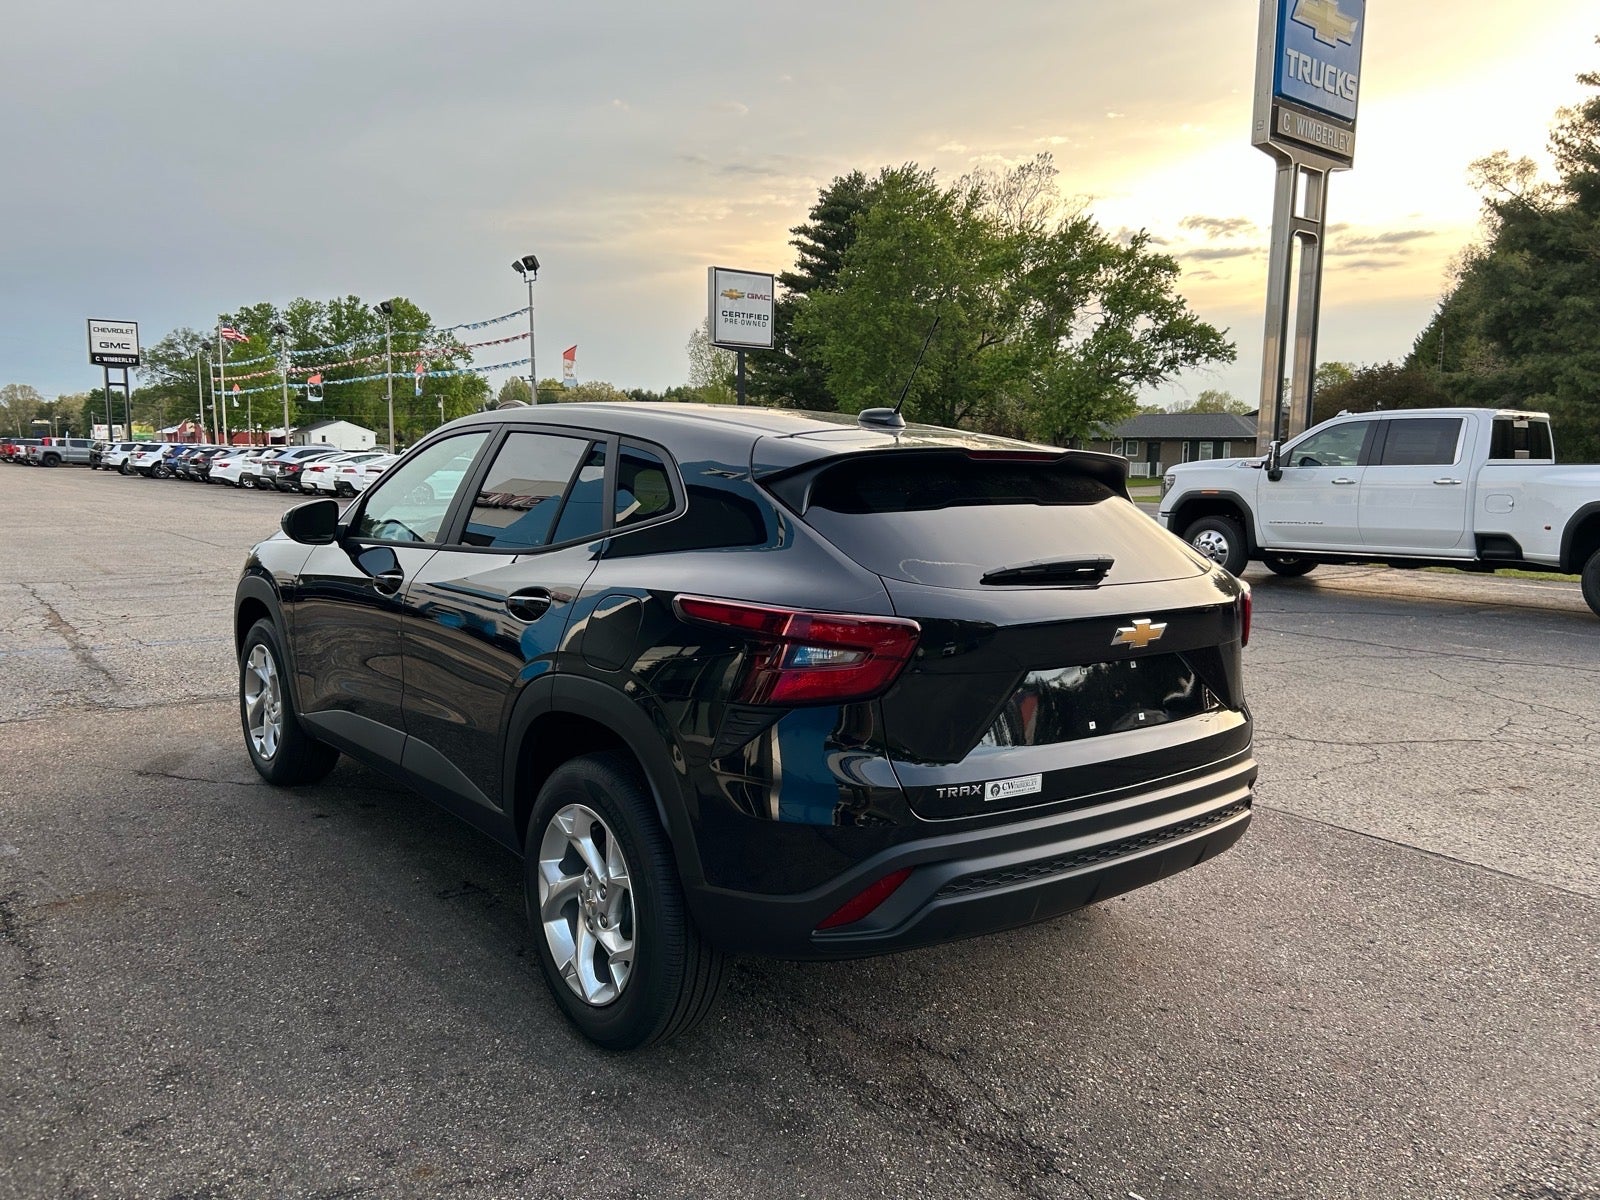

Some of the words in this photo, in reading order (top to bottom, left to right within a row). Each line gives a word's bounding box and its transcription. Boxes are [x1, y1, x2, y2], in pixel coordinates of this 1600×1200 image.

[1286, 47, 1357, 102] TRUCKS
[1296, 116, 1350, 153] WIMBERLEY
[747, 292, 771, 302] GMC
[721, 310, 769, 321] CERTIFIED
[724, 317, 767, 328] PRE-OWNED
[92, 326, 134, 335] CHEVROLET
[99, 341, 131, 350] GMC
[936, 784, 982, 799] TRAX
